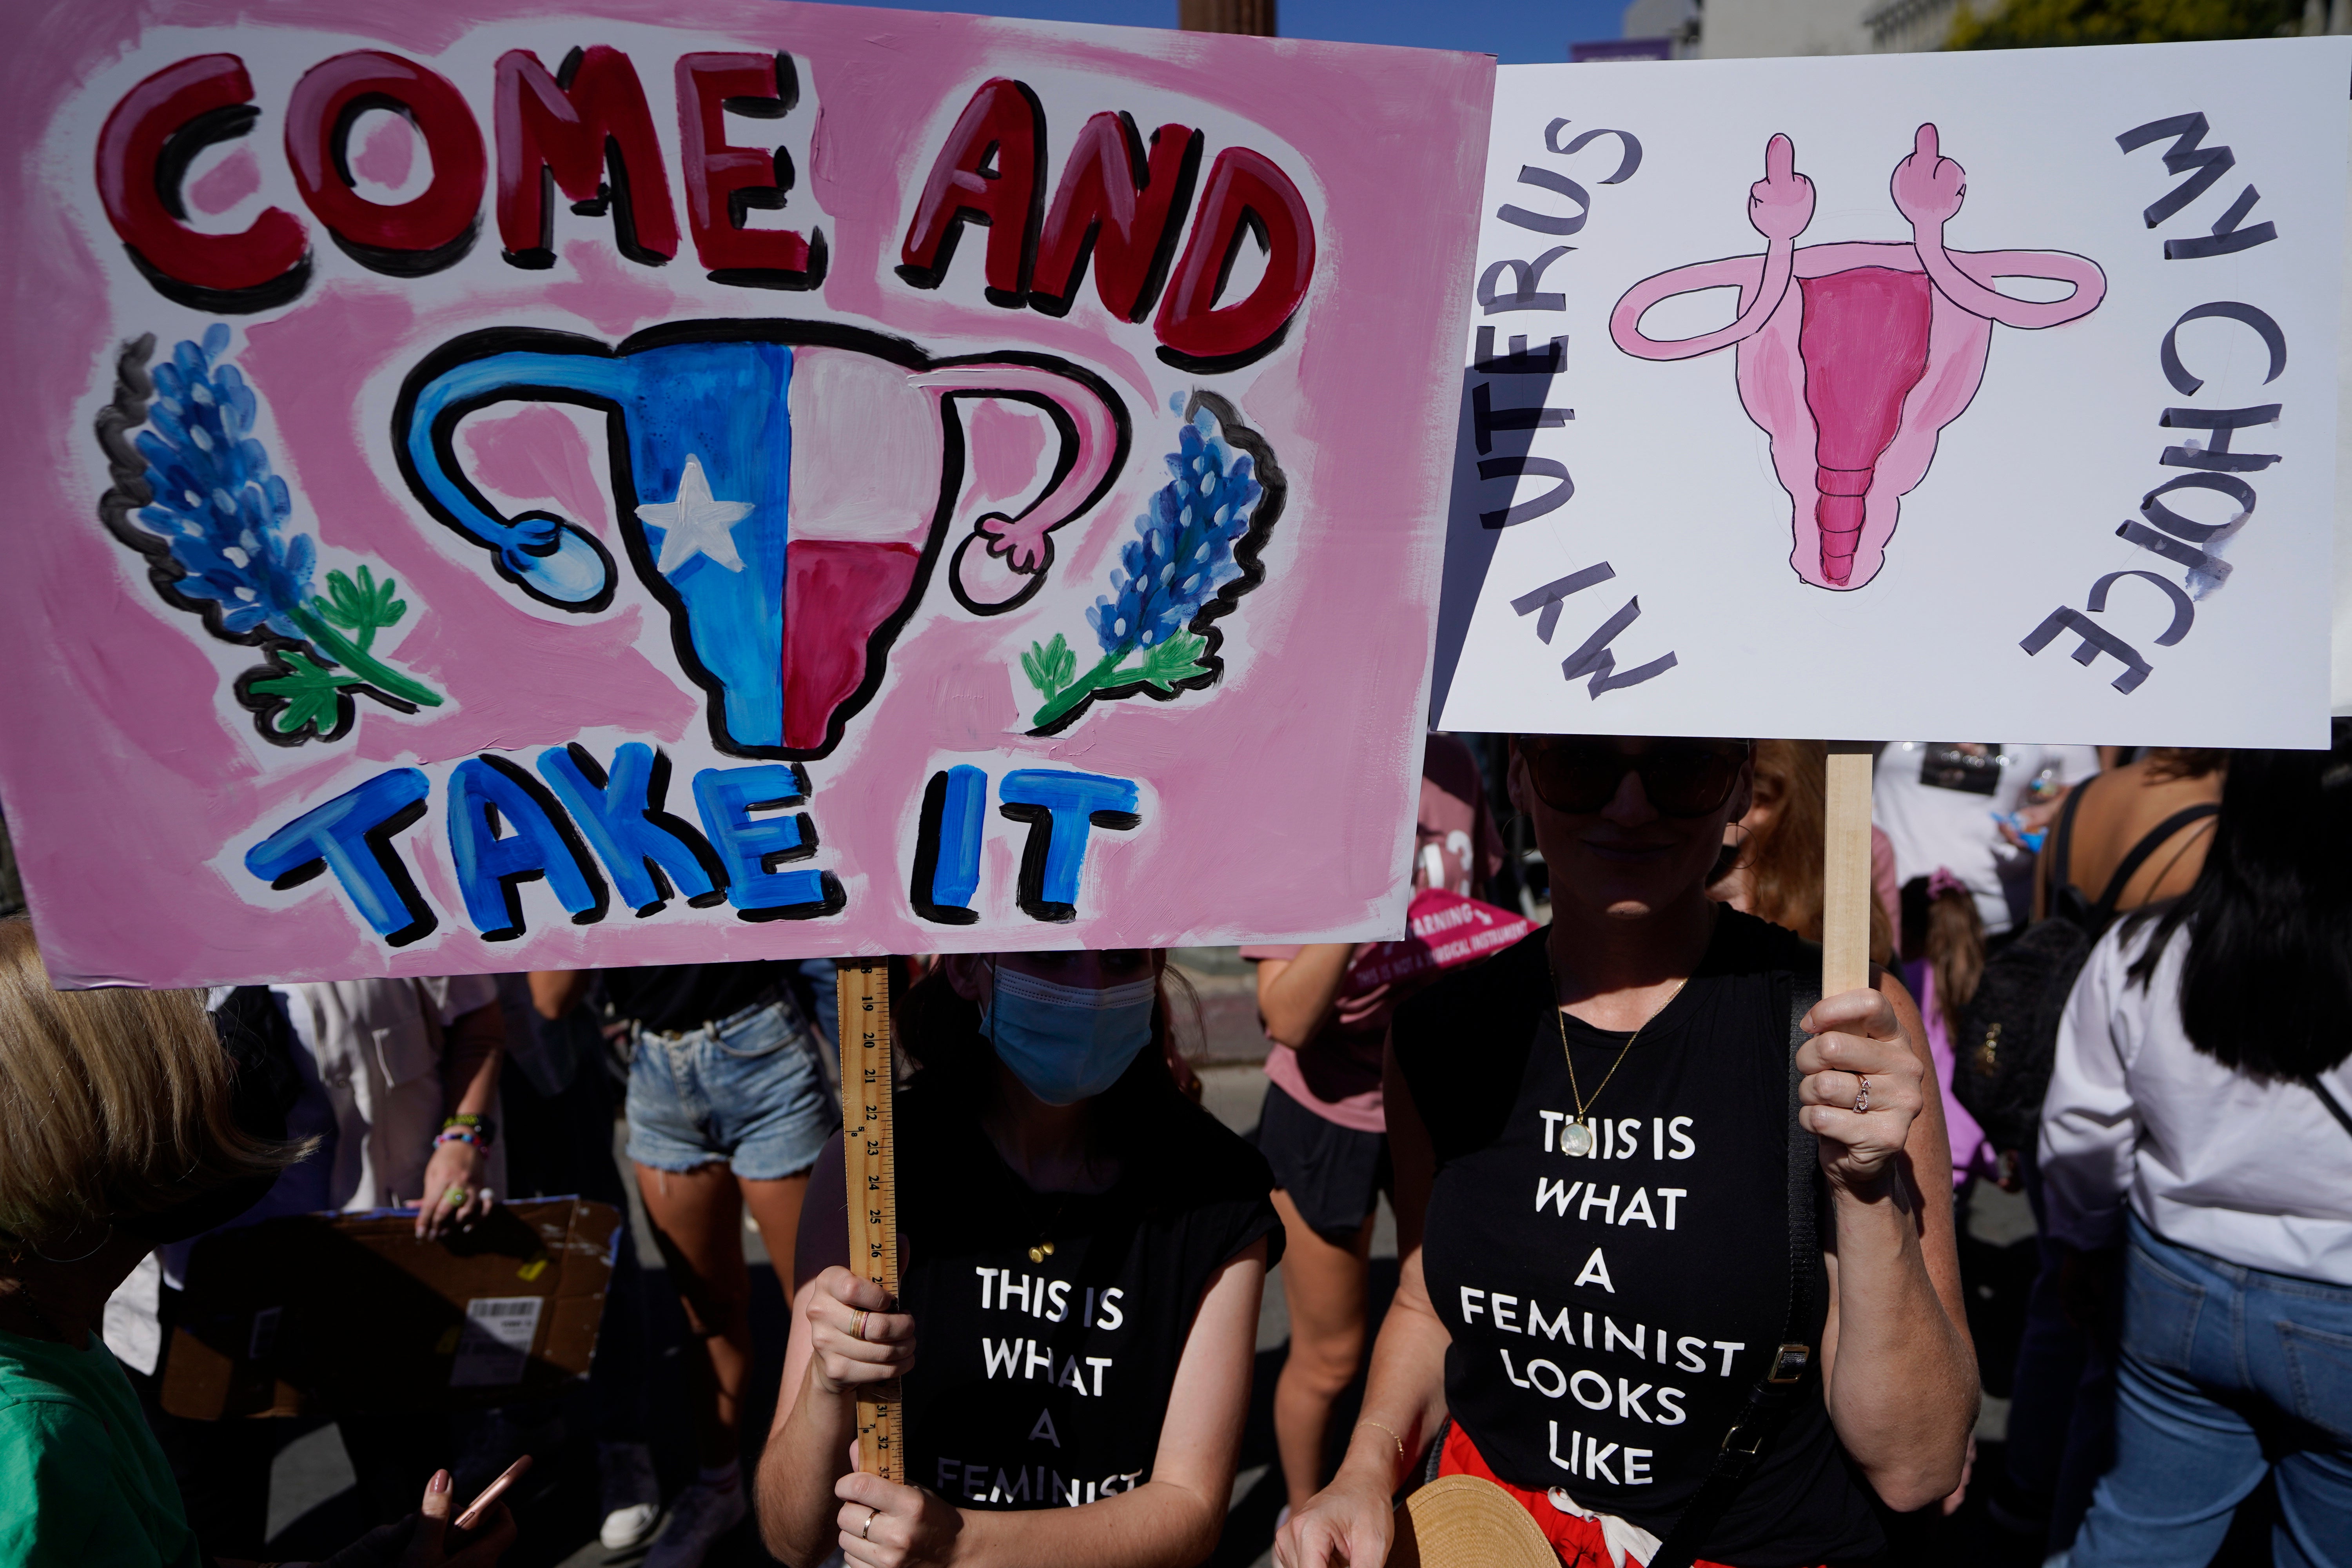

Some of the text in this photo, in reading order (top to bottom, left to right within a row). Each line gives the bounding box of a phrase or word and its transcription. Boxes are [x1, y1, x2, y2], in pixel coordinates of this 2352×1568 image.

[95, 45, 1316, 373] COME AND
[1472, 117, 1643, 529] UTERUS
[2019, 111, 2287, 695] MY CHOICE
[1510, 561, 1678, 701] MY
[245, 742, 1142, 947] TAKE IT
[1405, 902, 1473, 941] ARNING
[862, 996, 873, 1011] 19
[863, 1033, 875, 1048] 20
[865, 1069, 876, 1084] 21
[866, 1105, 877, 1121] 22
[867, 1140, 879, 1156] 23
[1653, 1116, 1696, 1161] IS
[868, 1175, 880, 1191] 24
[1536, 1176, 1687, 1231] WHAT
[870, 1209, 881, 1224] 25
[871, 1243, 882, 1258] 26
[1574, 1247, 1615, 1294] A
[976, 1267, 1124, 1330] THIS IS
[1460, 1285, 1745, 1377] FEMINIST
[982, 1338, 1112, 1397] WHAT
[1500, 1348, 1686, 1426] LOOKS
[877, 1405, 887, 1418] 31
[1028, 1408, 1061, 1448] A
[878, 1436, 889, 1450] 32
[1549, 1420, 1653, 1485] LIKE
